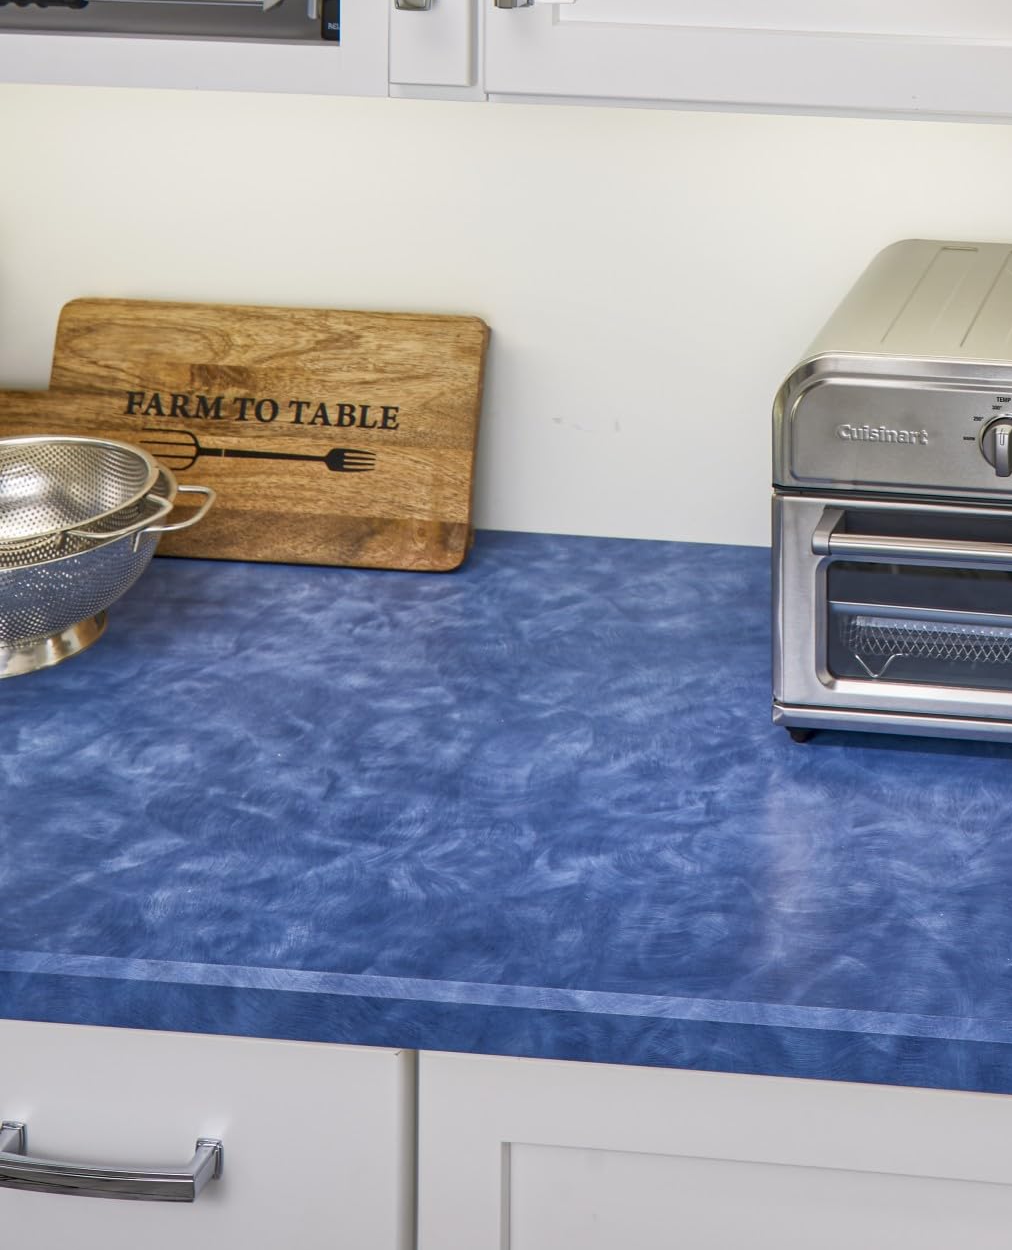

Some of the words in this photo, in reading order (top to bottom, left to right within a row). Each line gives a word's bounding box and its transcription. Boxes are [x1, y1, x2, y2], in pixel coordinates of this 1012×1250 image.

[123, 391, 225, 420] FARM
[232, 397, 279, 423] TO
[288, 400, 400, 430] TABLE
[837, 423, 929, 446] Cuisinart
